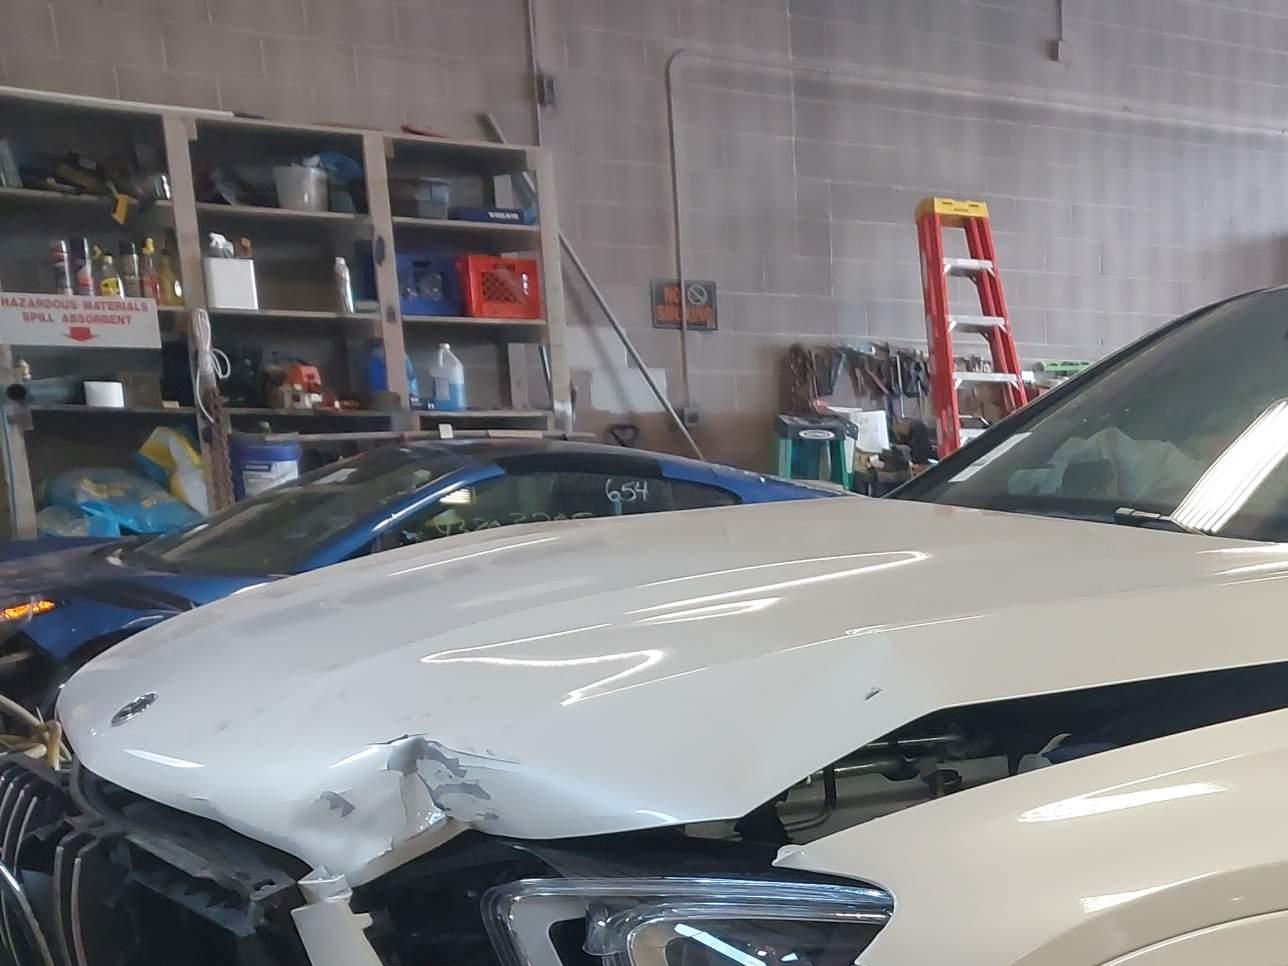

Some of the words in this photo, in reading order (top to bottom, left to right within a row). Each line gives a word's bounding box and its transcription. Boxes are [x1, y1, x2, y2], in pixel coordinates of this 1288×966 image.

[1, 297, 78, 310] HAZARDOUS
[83, 300, 149, 312] MATERIALS
[22, 311, 54, 323] SPILL
[62, 312, 133, 325] ABSORBENT
[605, 478, 648, 502] 654
